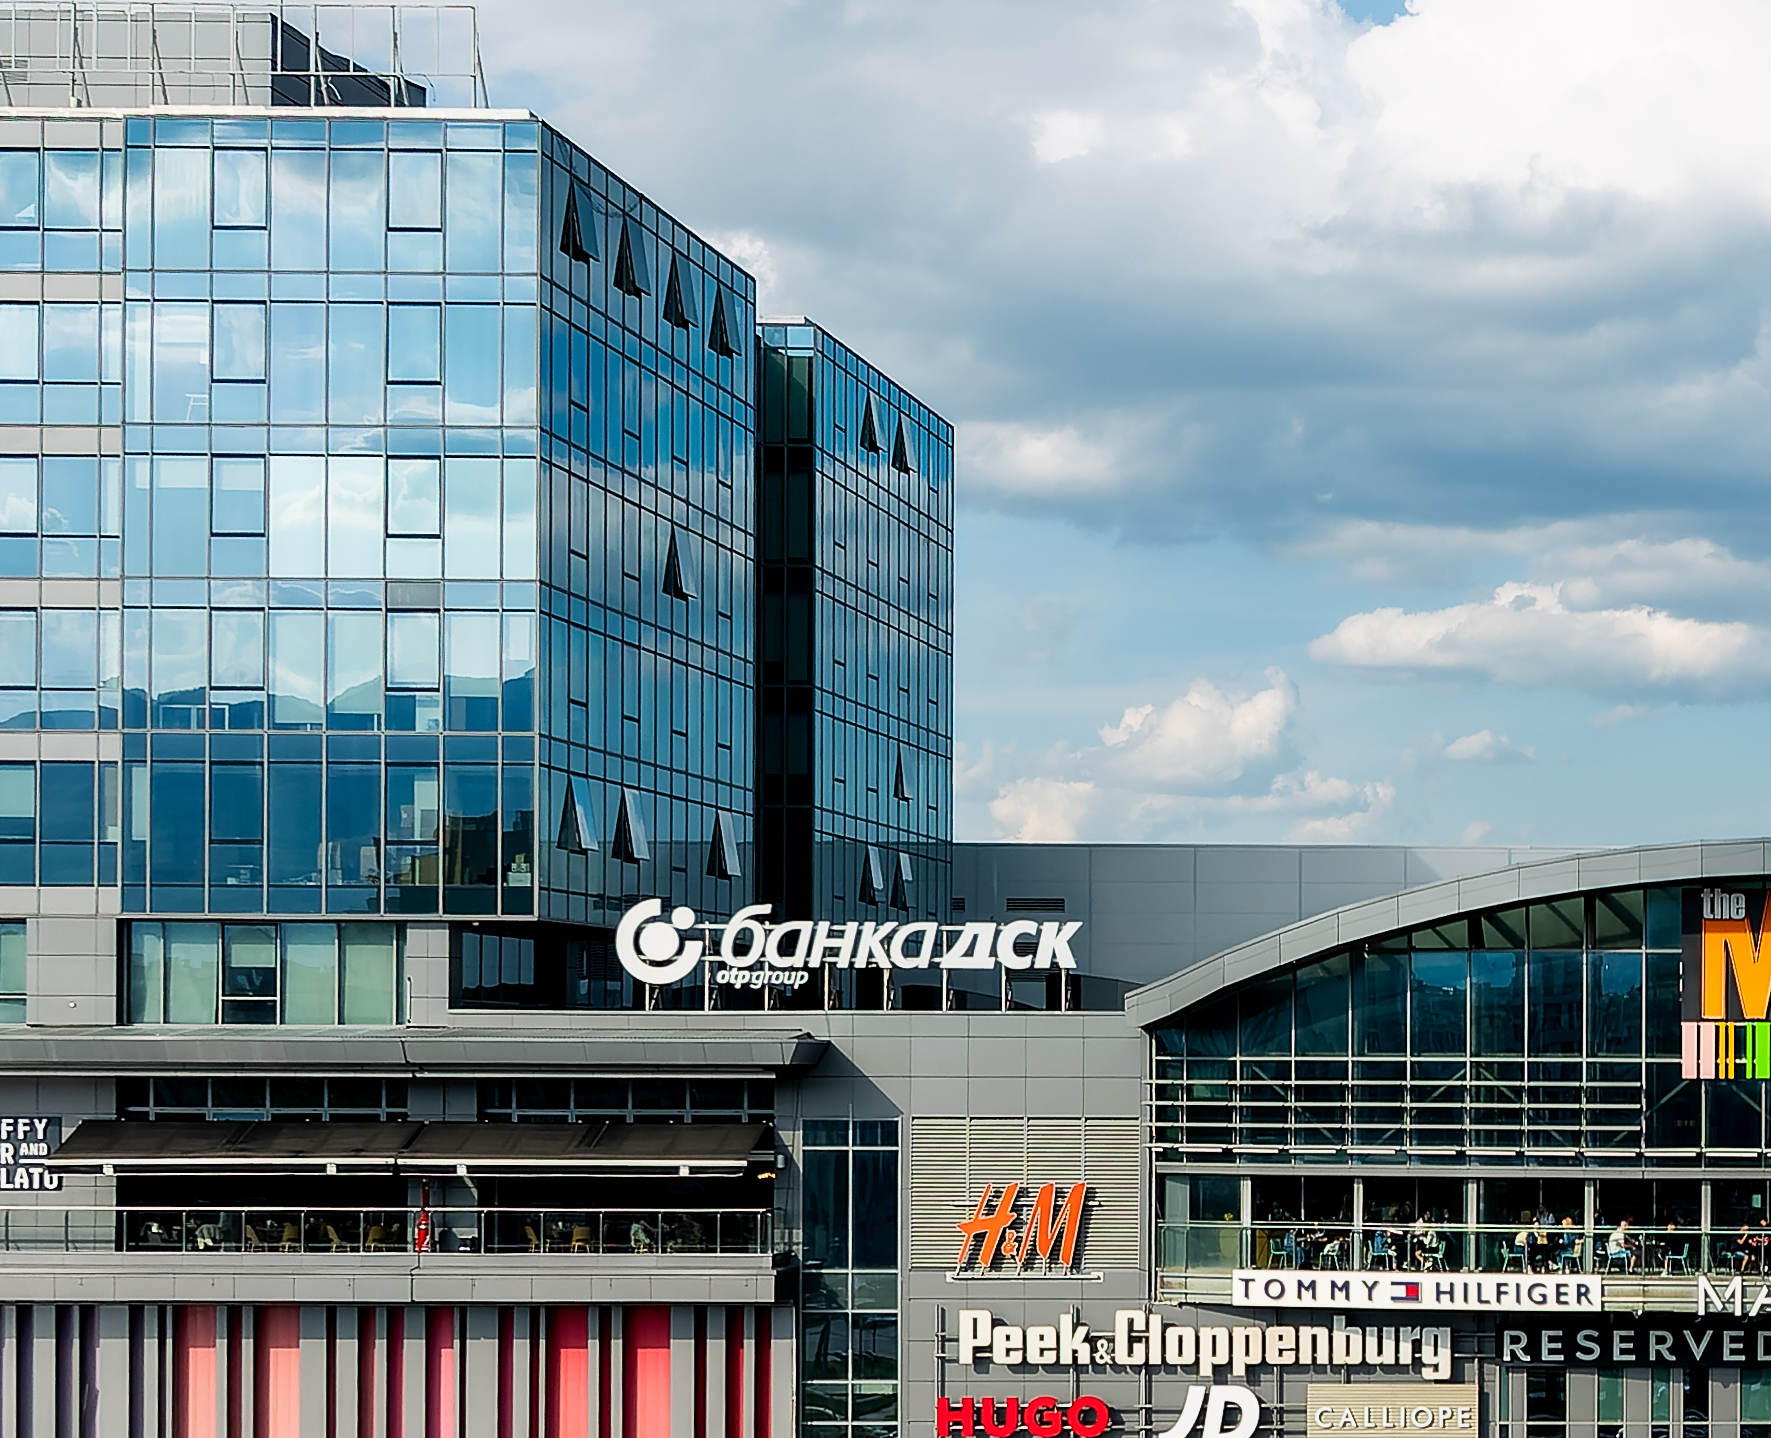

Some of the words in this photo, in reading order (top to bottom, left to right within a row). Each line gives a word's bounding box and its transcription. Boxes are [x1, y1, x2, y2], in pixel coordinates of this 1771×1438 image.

[1701, 888, 1746, 920] the
[19, 1142, 48, 1156] AND
[957, 1181, 1087, 1268] H&M
[1239, 1277, 1380, 1302] TOMMY
[1436, 1281, 1595, 1306] HILFIGER
[936, 1396, 1110, 1438] HUGO
[1315, 1405, 1473, 1430] CALLIOPE
